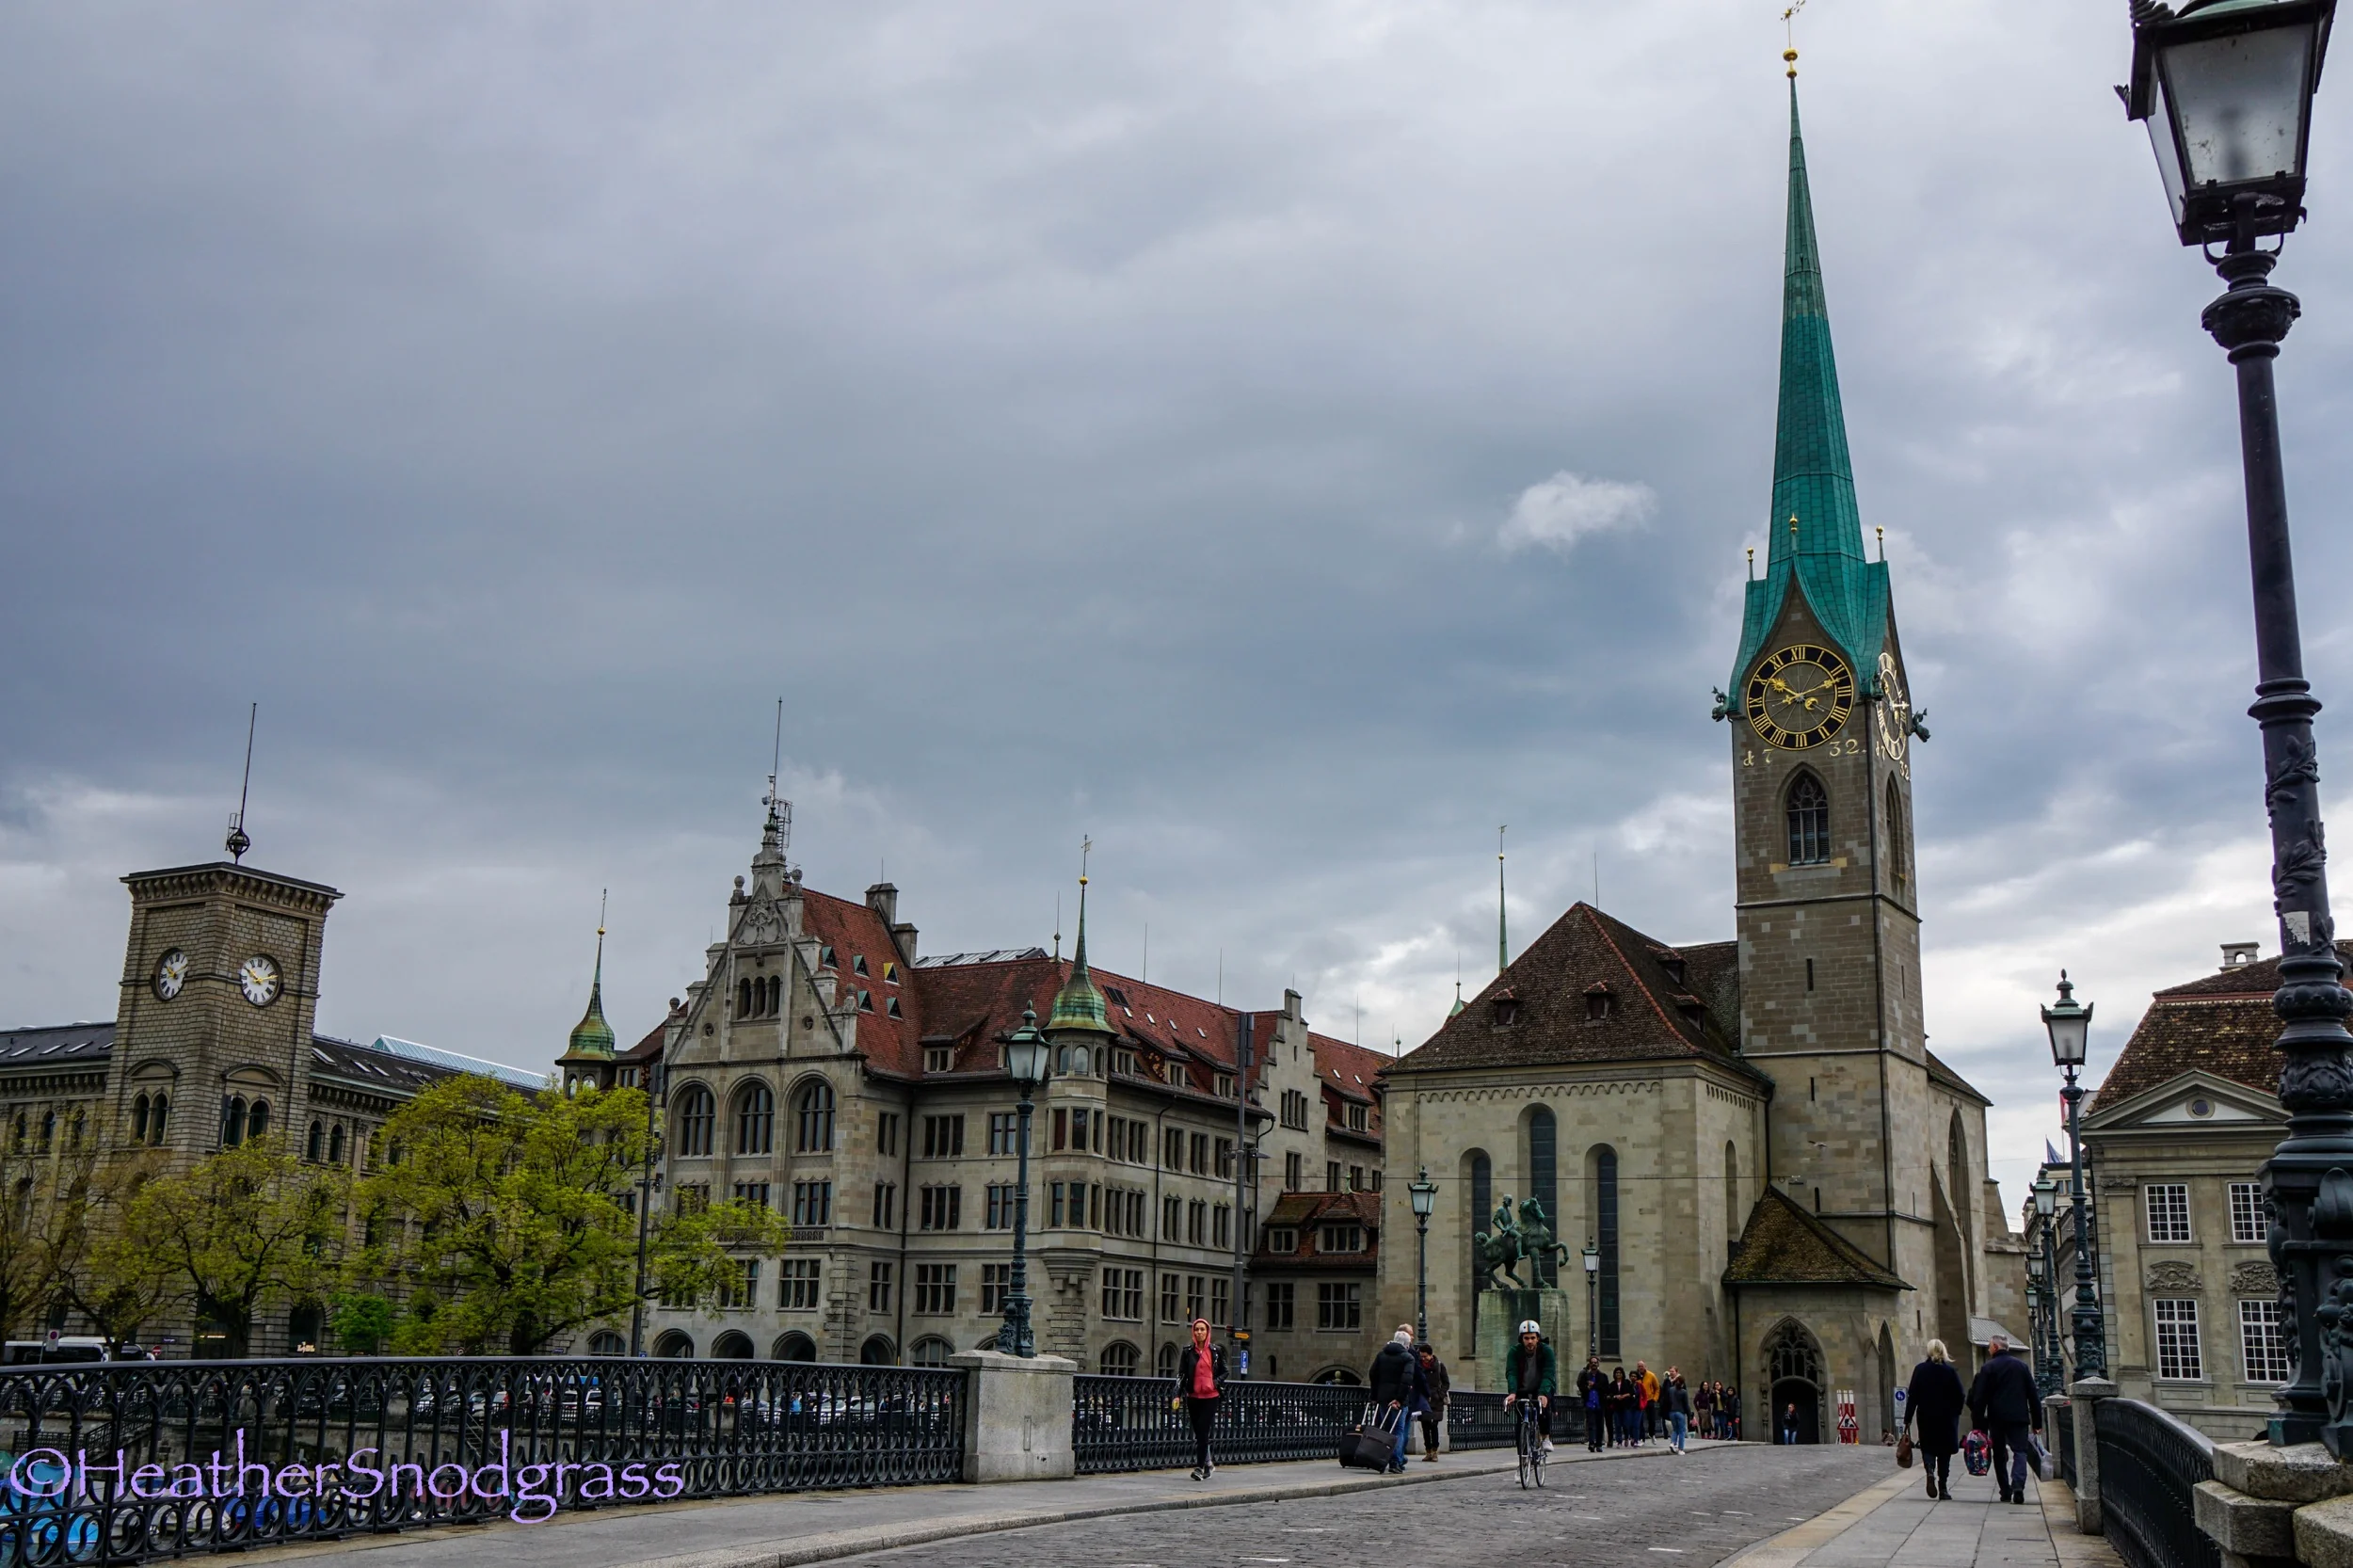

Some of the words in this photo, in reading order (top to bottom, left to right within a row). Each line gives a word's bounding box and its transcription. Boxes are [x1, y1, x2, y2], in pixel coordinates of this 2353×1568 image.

[1790, 647, 1806, 661] XII
[1817, 650, 1825, 663] I
[1769, 654, 1785, 670] XI
[1831, 664, 1845, 677] II
[1837, 685, 1851, 697] III
[1831, 705, 1849, 723] IIII
